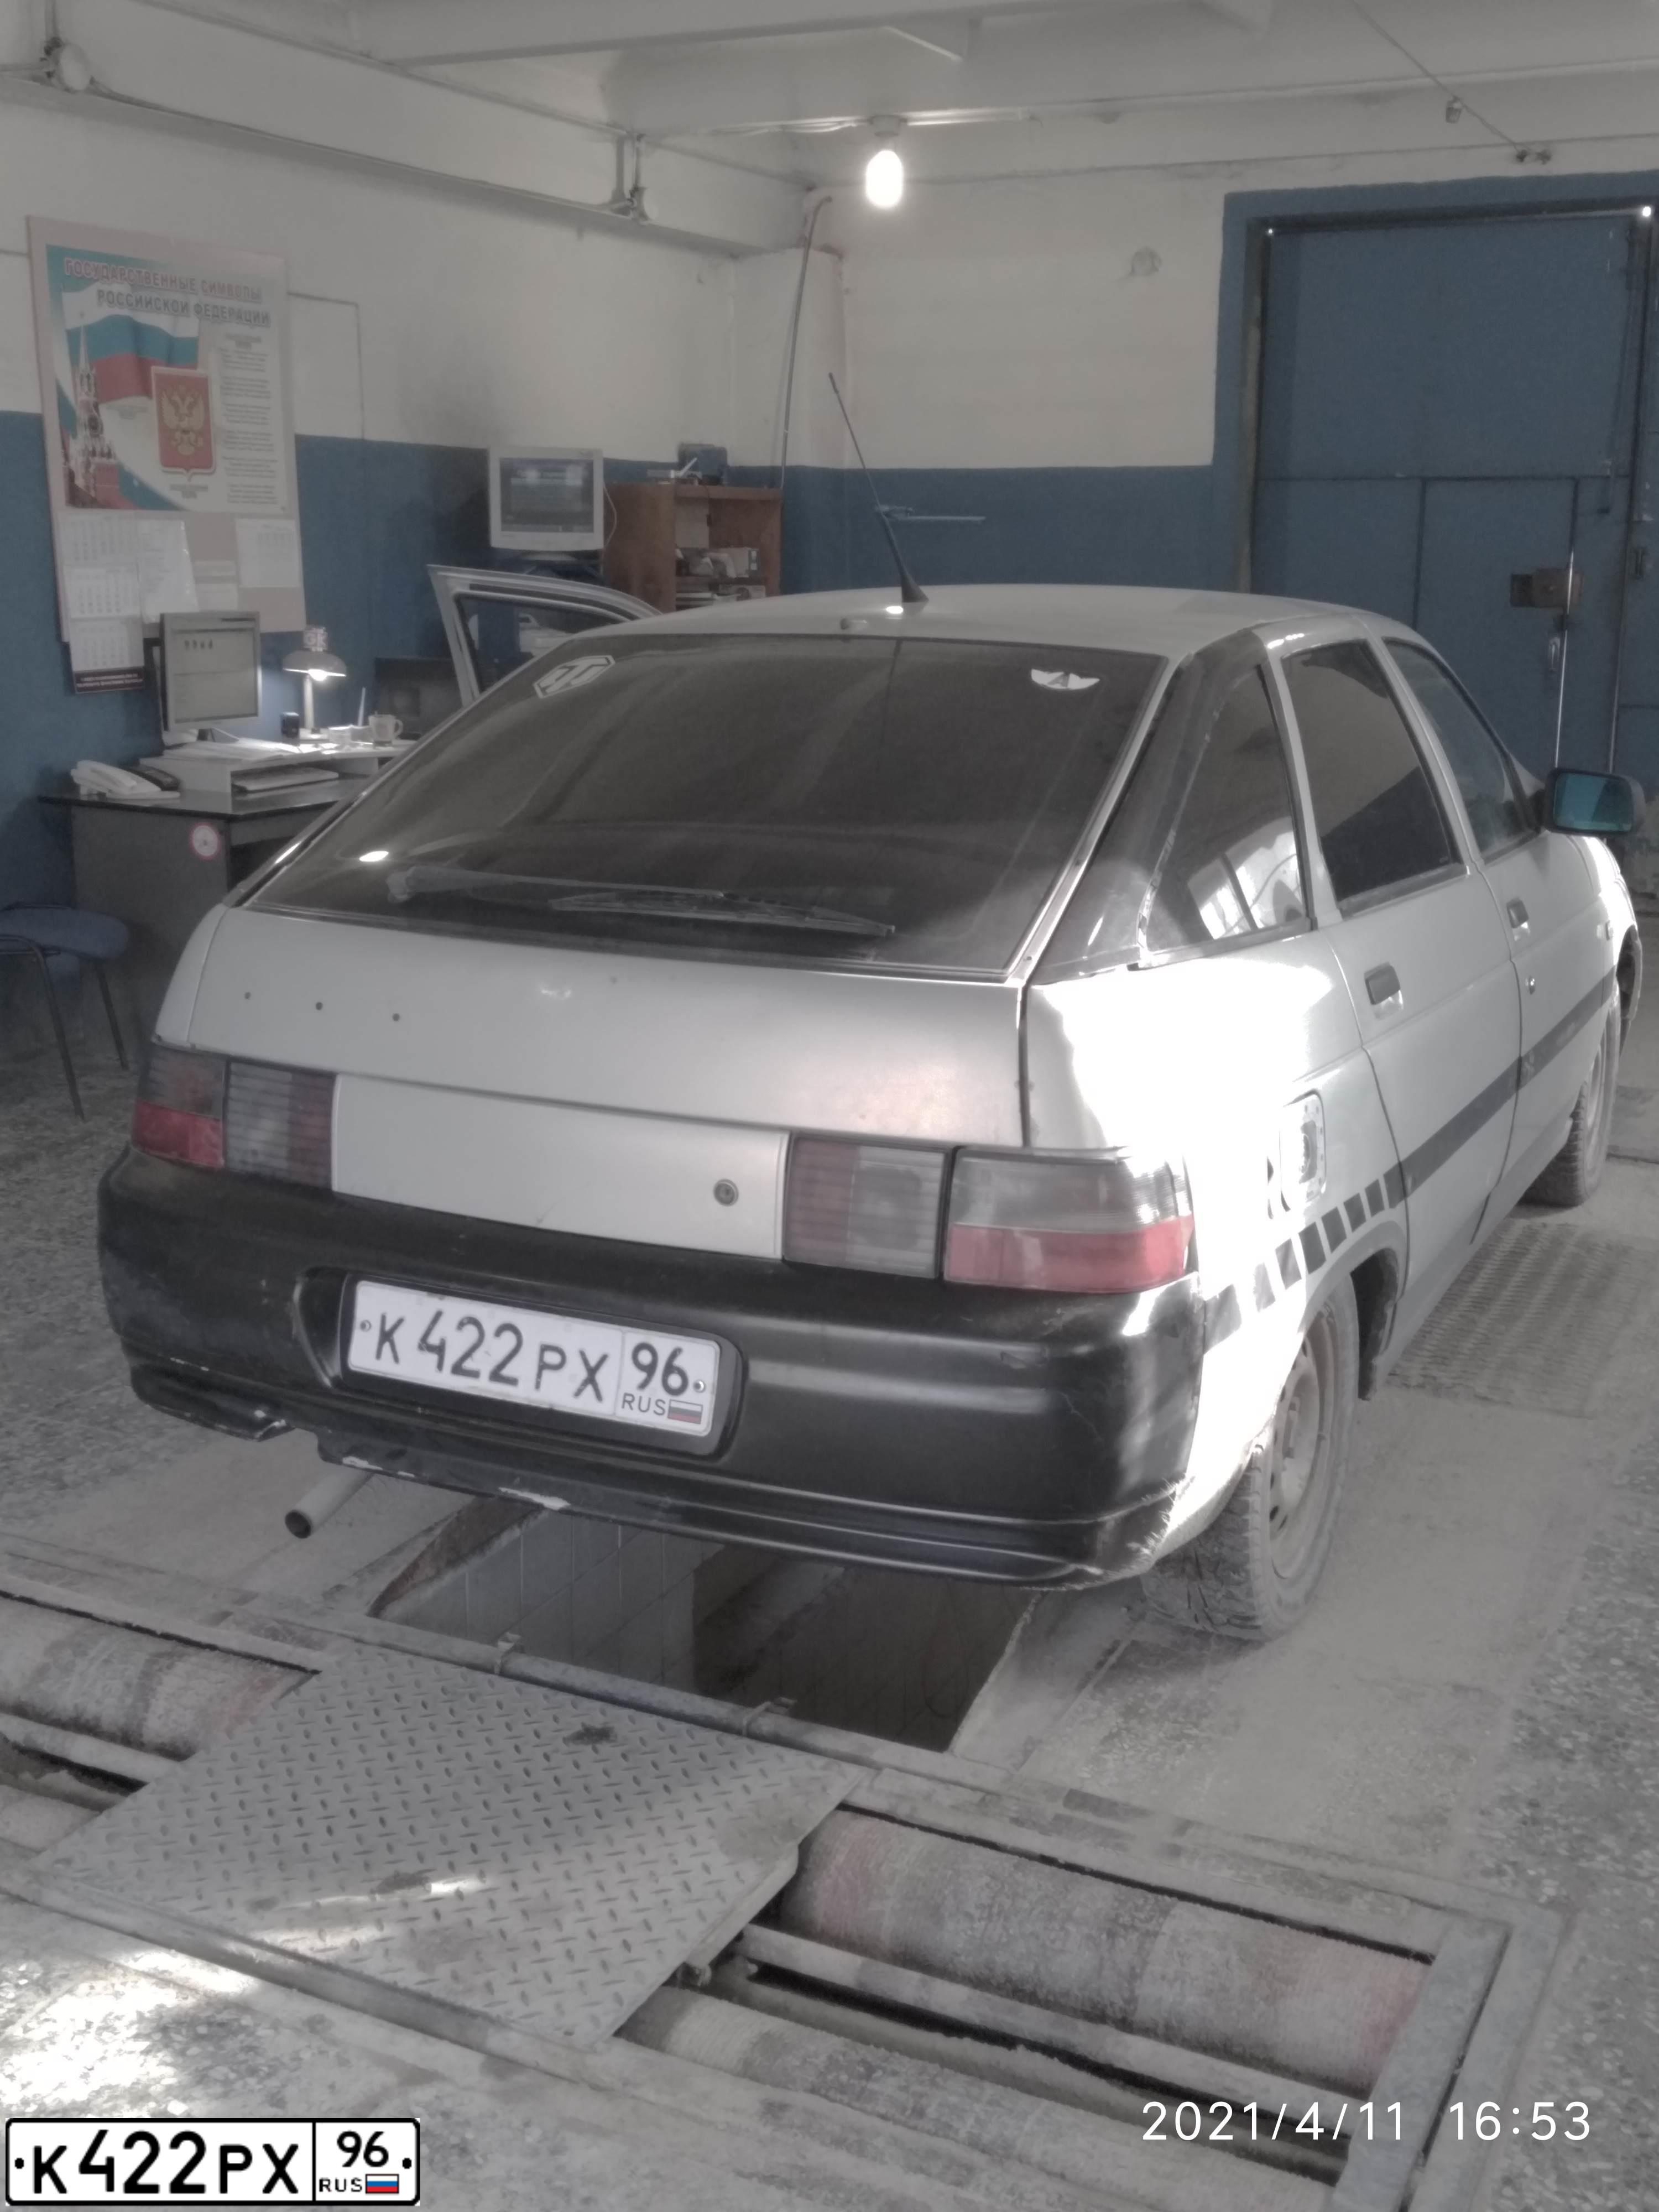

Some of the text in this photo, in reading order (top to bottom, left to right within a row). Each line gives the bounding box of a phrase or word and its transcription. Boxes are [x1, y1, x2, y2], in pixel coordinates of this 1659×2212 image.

[65, 258, 262, 300] ГОСУДАРСТВЕННЫЕ СИМВОЛЫ
[194, 302, 271, 325] ФЕДЕРАЦИИ
[630, 1342, 689, 1396] 96
[621, 1392, 666, 1416] RUS
